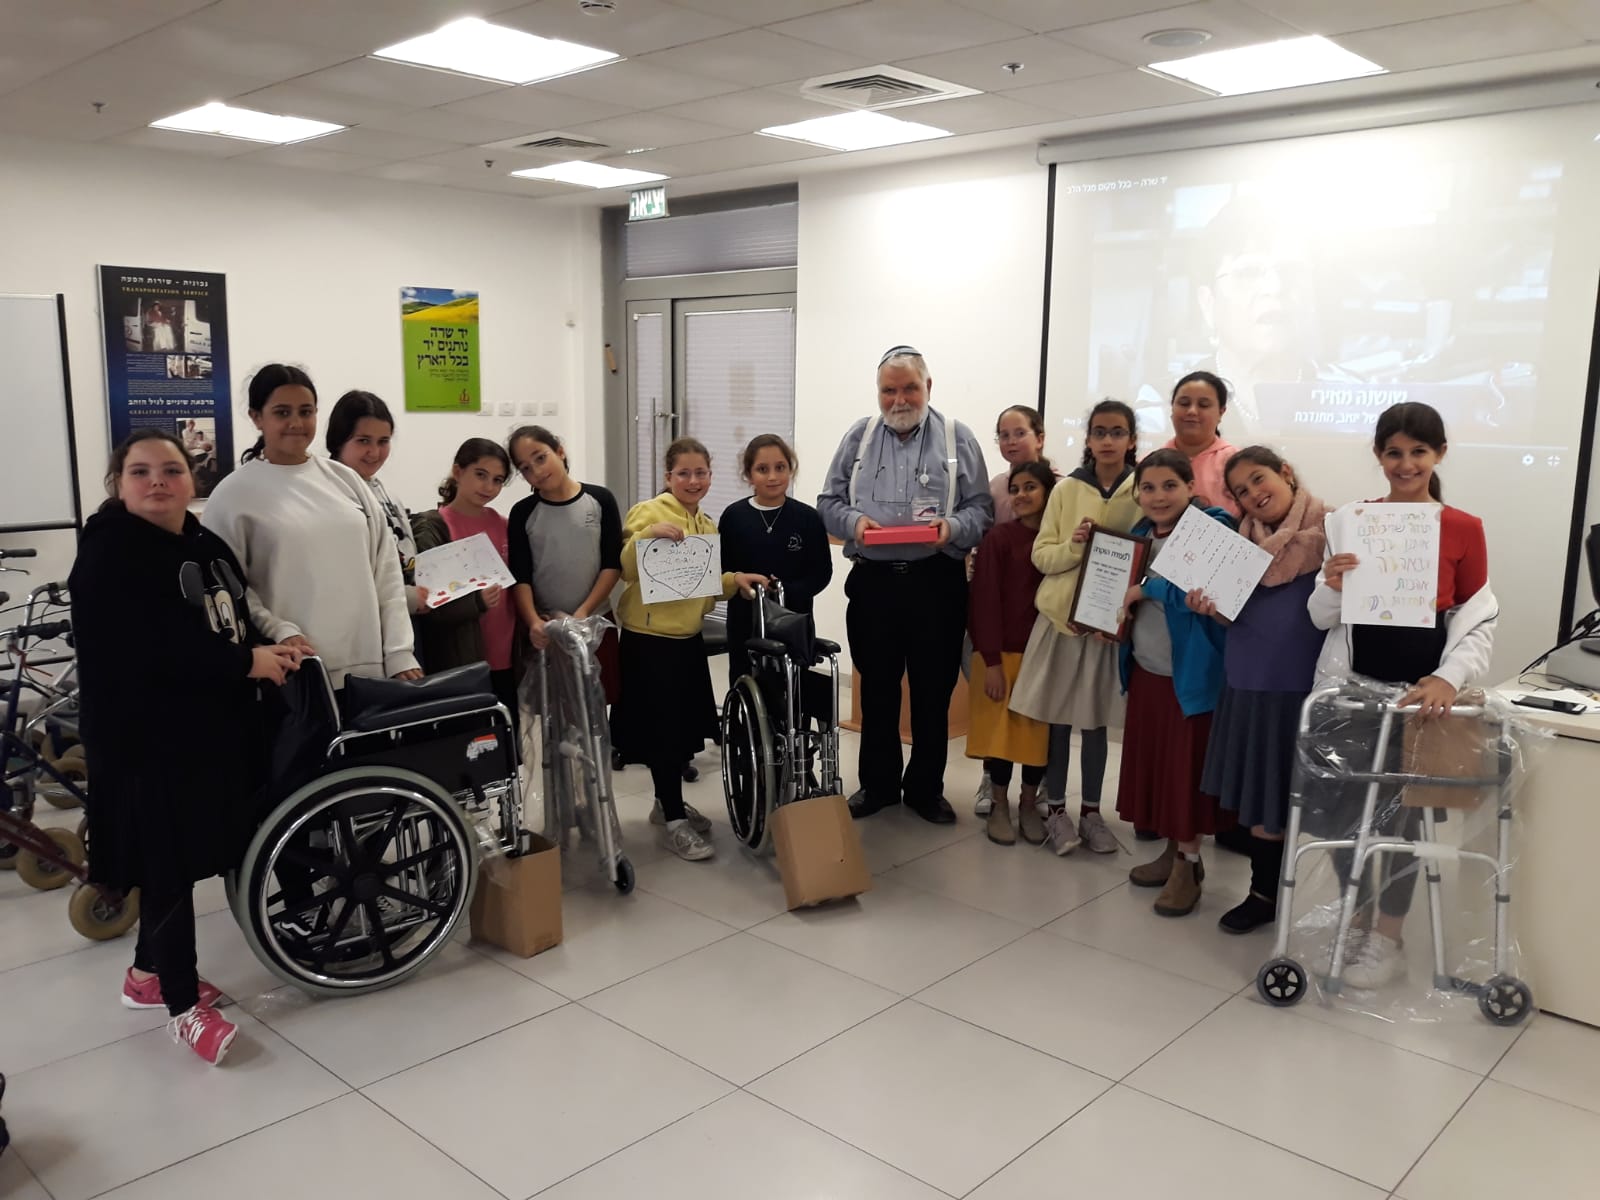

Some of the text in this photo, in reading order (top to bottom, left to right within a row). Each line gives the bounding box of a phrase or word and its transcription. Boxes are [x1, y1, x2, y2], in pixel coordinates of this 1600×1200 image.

[122, 286, 180, 295] TRANSPORTATION
[430, 326, 468, 338] יד שרה
[423, 339, 469, 352] נותנים יד
[417, 352, 469, 370] בכל הארץ
[148, 397, 164, 406] לגיל
[1356, 389, 1408, 406] שושנה
